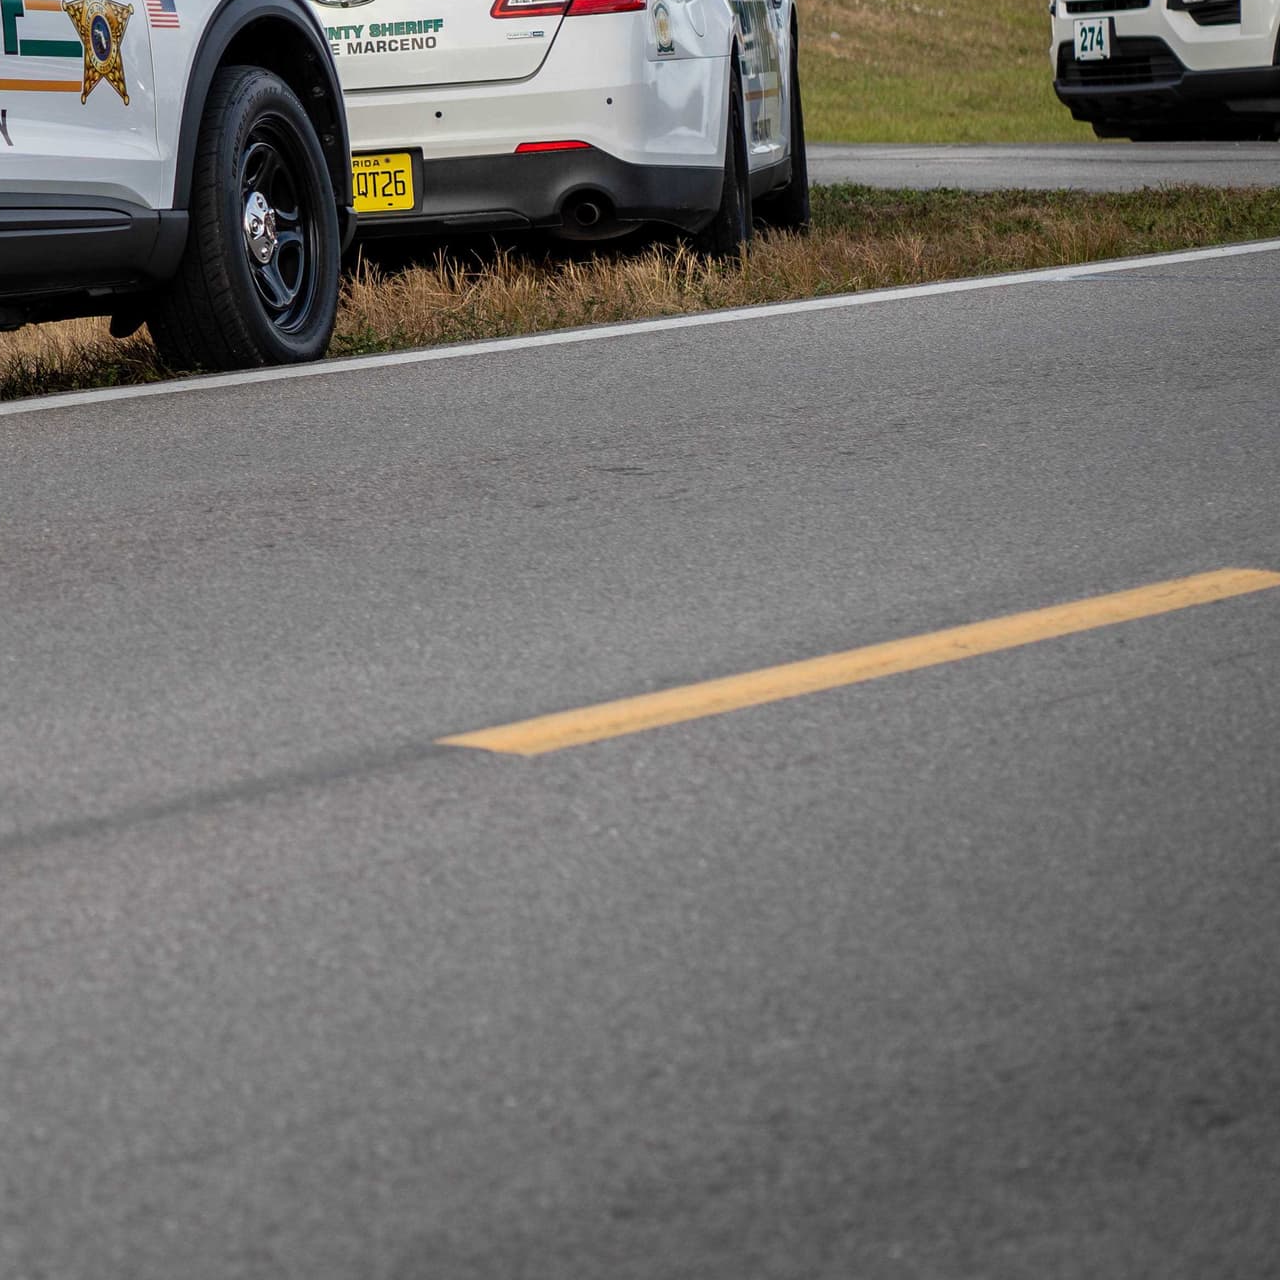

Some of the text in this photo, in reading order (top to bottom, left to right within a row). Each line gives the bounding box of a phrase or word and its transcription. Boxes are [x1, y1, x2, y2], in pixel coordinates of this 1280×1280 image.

[369, 18, 444, 38] SHERIFF
[347, 36, 437, 55] MARCENO
[1080, 26, 1104, 52] 274
